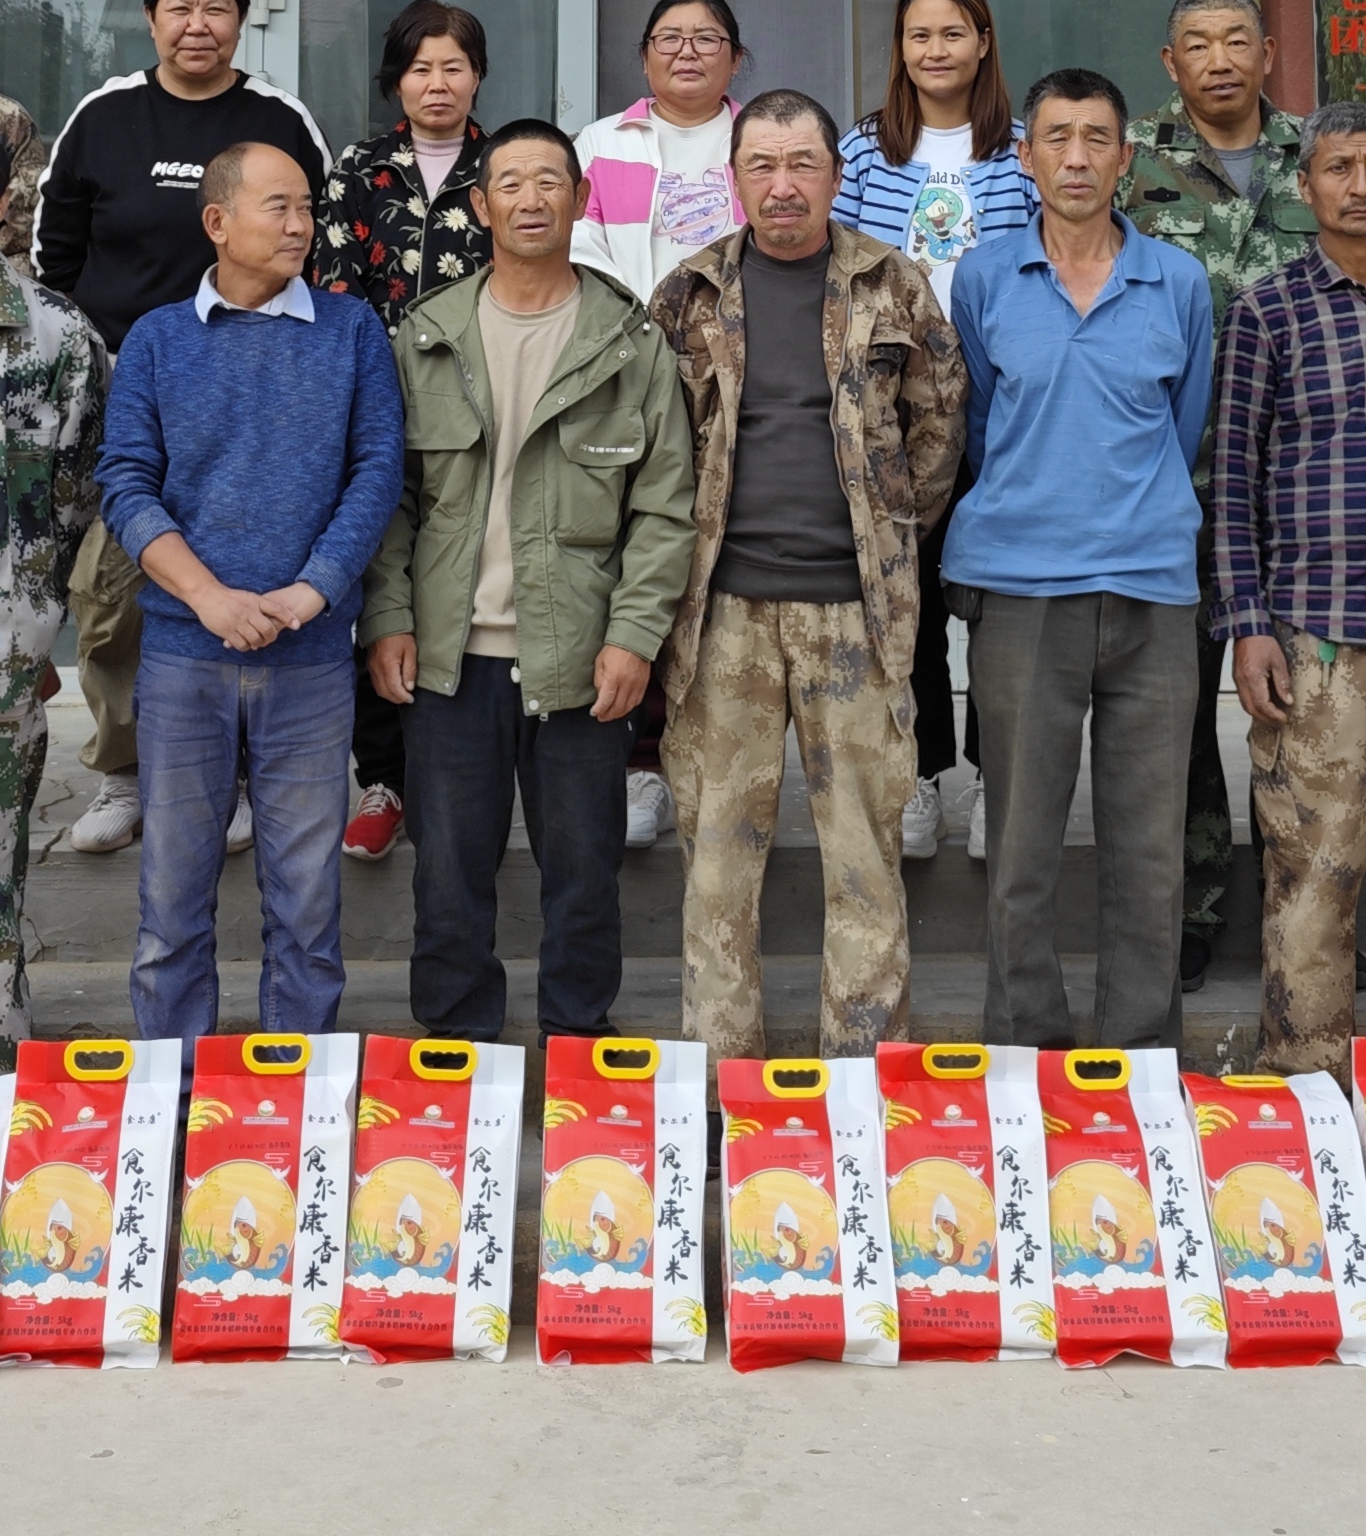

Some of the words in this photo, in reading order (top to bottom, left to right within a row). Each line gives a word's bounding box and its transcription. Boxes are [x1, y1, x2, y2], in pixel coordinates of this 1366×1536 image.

[950, 173, 965, 185] D
[116, 1149, 157, 1292] 食尔康香米
[299, 1147, 339, 1291] 食尔康香米
[465, 1147, 504, 1290] 食尔康香米
[658, 1145, 698, 1284] 食尔康香米
[837, 1155, 883, 1289] 食尔康香米
[997, 1146, 1042, 1287] 食尔康香米
[1149, 1146, 1205, 1282] 食尔康香米
